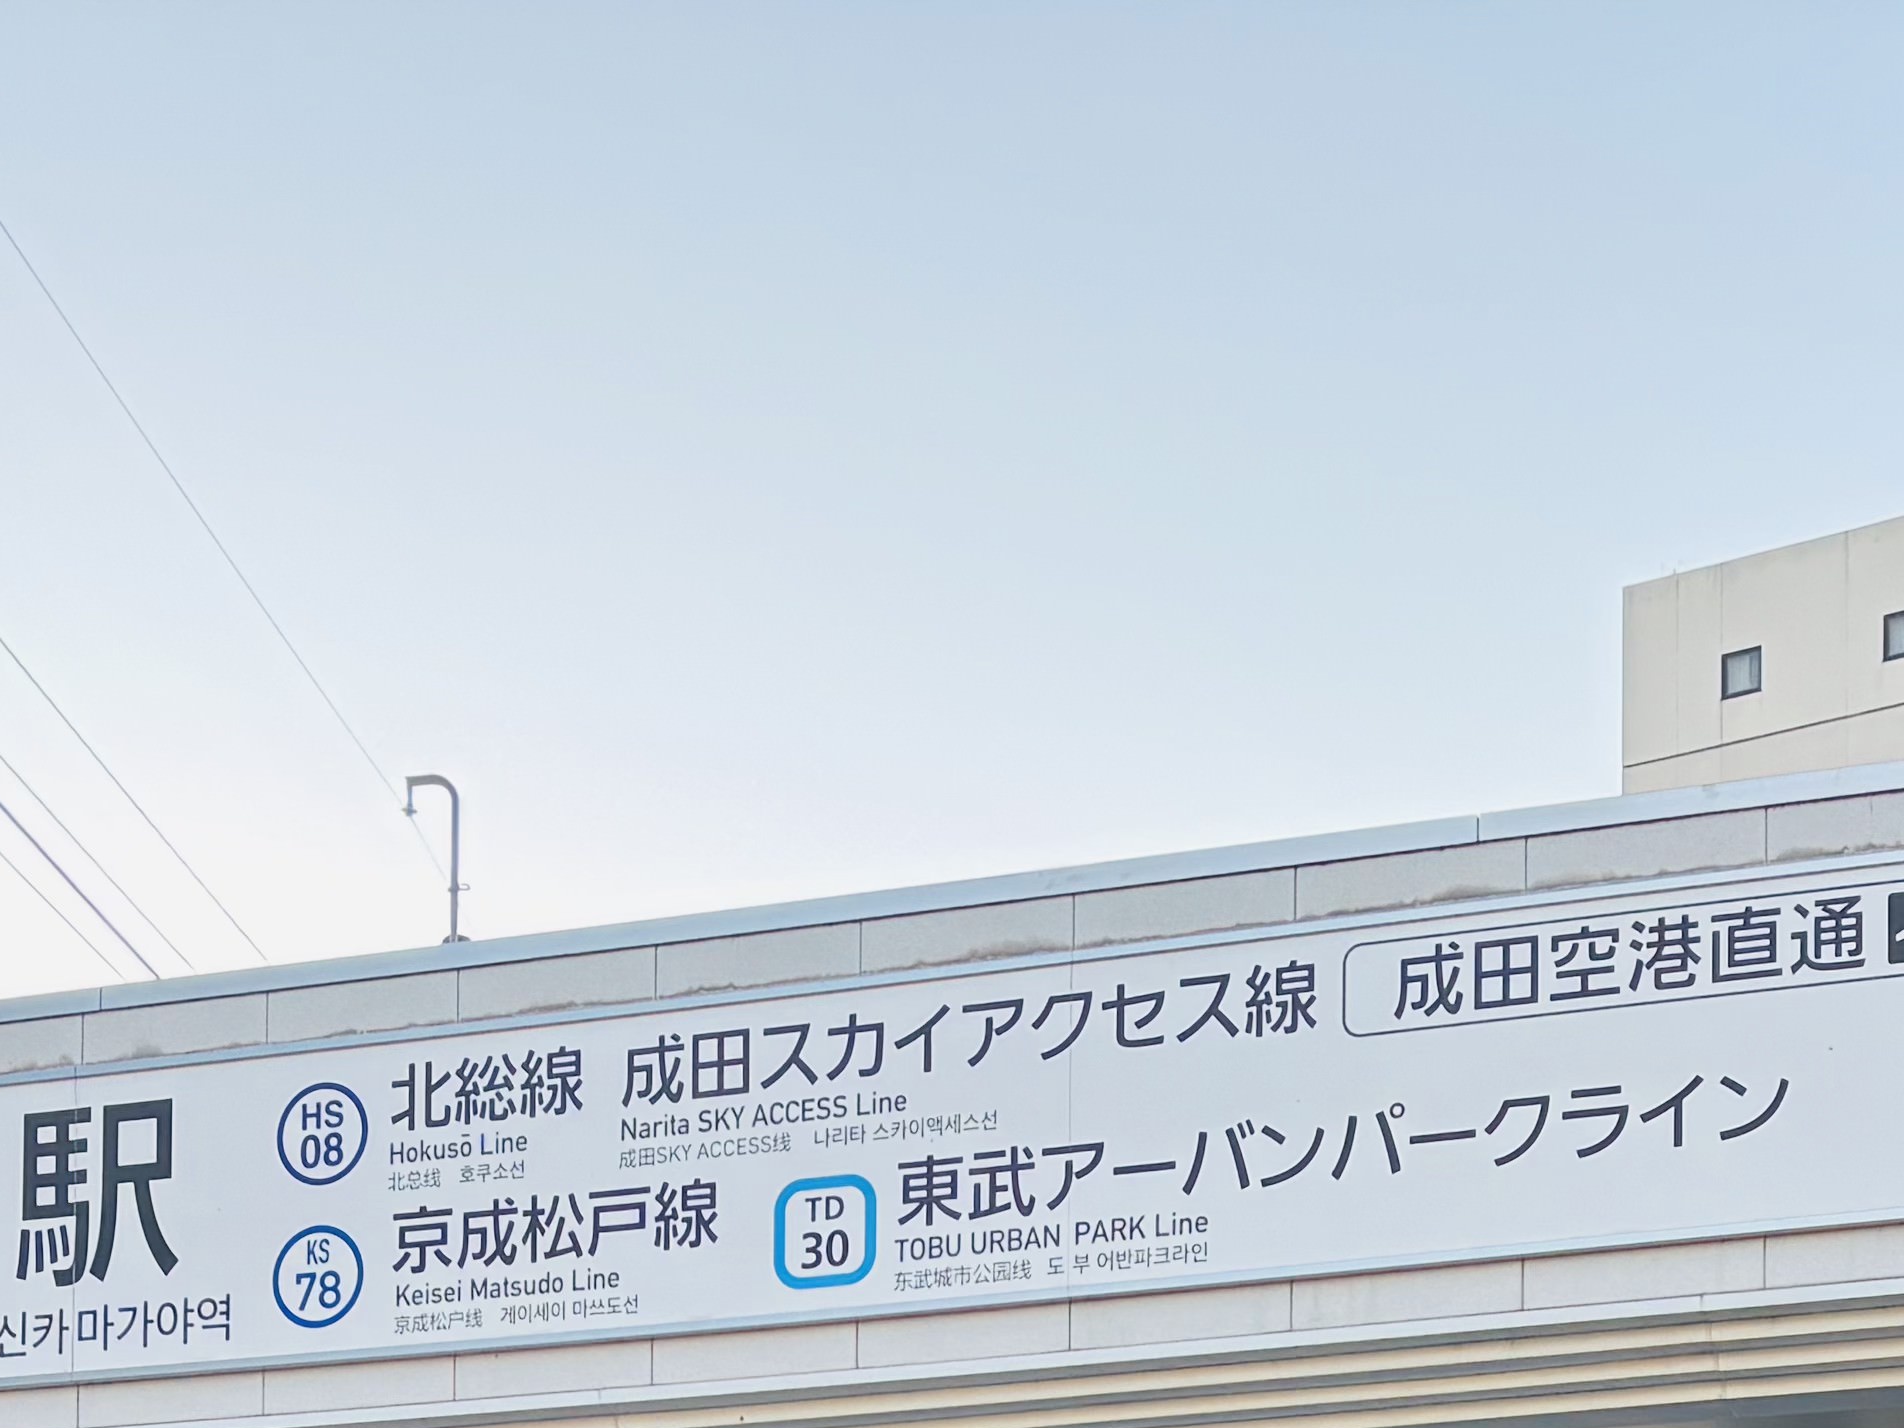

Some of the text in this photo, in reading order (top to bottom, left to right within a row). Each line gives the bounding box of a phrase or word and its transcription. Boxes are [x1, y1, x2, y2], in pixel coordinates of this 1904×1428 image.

[1393, 894, 1864, 1021] 成田空港直通
[621, 959, 1317, 1108] 成田スカイアクセス線
[391, 1045, 583, 1131] 北総線
[300, 1100, 344, 1130] HS
[621, 1091, 907, 1142] Narita SKY ACCESS Line
[813, 1110, 998, 1149] 나리타 스카이액세스선
[299, 1132, 344, 1169] 08
[389, 1132, 527, 1165] Hokusō Line
[896, 1073, 1790, 1228] 東武アーバンパークライン
[459, 1160, 526, 1183] 호쿠소선
[391, 1177, 720, 1274] 京成松戸線
[805, 1195, 845, 1224] TD
[307, 1239, 330, 1265] KS
[800, 1229, 849, 1271] 30
[895, 1212, 1208, 1262] TOBU URBAN PARK Line
[295, 1270, 341, 1311] 78
[395, 1267, 620, 1307] Keisei Matsudo Line
[500, 1300, 566, 1325] 게이세이
